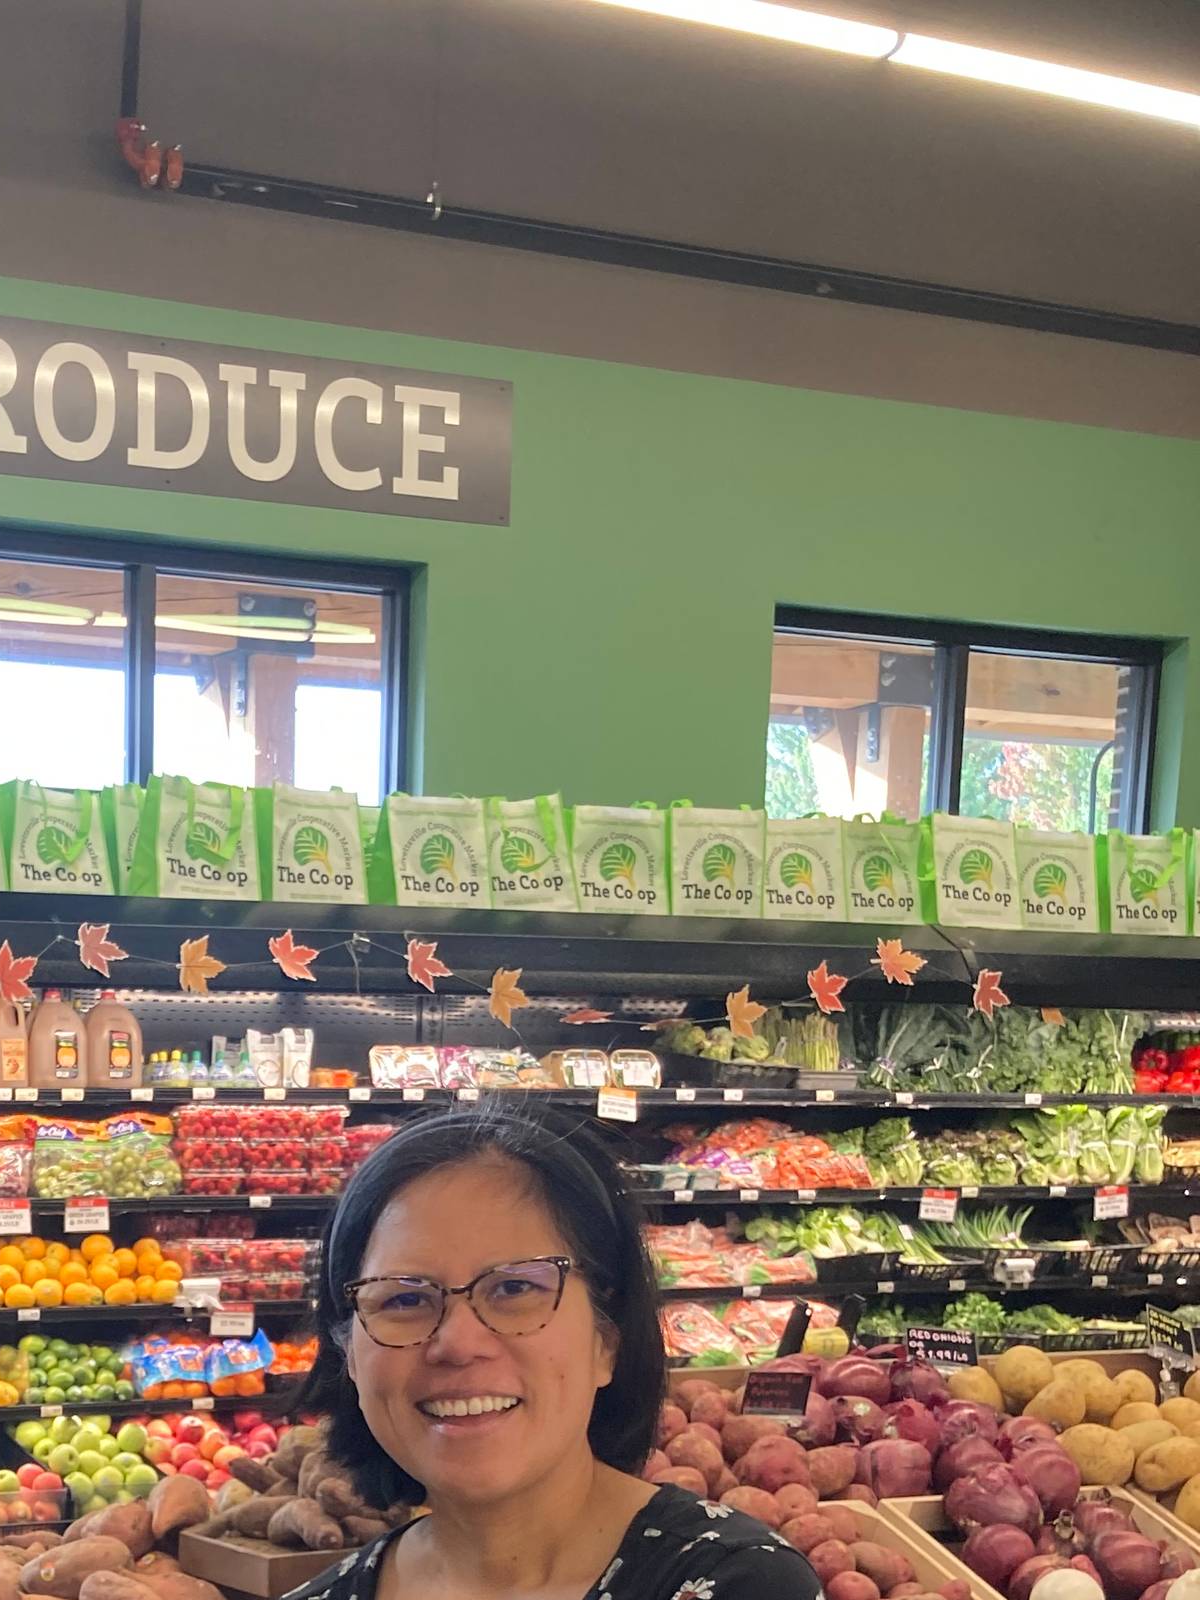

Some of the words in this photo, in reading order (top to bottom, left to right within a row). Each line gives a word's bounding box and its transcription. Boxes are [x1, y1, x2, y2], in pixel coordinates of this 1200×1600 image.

[20, 863, 51, 881] The
[55, 867, 77, 882] Co
[81, 872, 102, 887] op
[166, 857, 196, 878] The
[200, 864, 222, 881] Co
[226, 872, 248, 888] op
[277, 865, 306, 884] The
[309, 868, 330, 884] Co
[334, 874, 354, 890] op
[519, 875, 539, 889] Co
[543, 875, 564, 891] op
[401, 874, 431, 892] The
[435, 876, 455, 893] Co
[459, 881, 480, 897] op
[580, 882, 610, 898] The
[614, 884, 633, 899] Co
[637, 889, 657, 905] op
[681, 883, 711, 900] The
[714, 884, 732, 900] Co
[735, 889, 753, 905] op
[942, 884, 969, 900] The
[972, 887, 991, 902] Co
[994, 892, 1012, 908] op
[765, 889, 793, 904] The
[795, 890, 814, 905] Co
[817, 895, 835, 910] op
[851, 892, 875, 907] The
[877, 893, 895, 908] Co
[898, 897, 914, 912] op
[1023, 899, 1043, 914] he
[1046, 901, 1064, 915] Co
[1068, 906, 1086, 920] op
[1116, 904, 1140, 919] The
[1142, 905, 1158, 919] Co
[1161, 909, 1177, 923] op
[909, 1329, 931, 1340] RED
[932, 1333, 973, 1345] ONIONS
